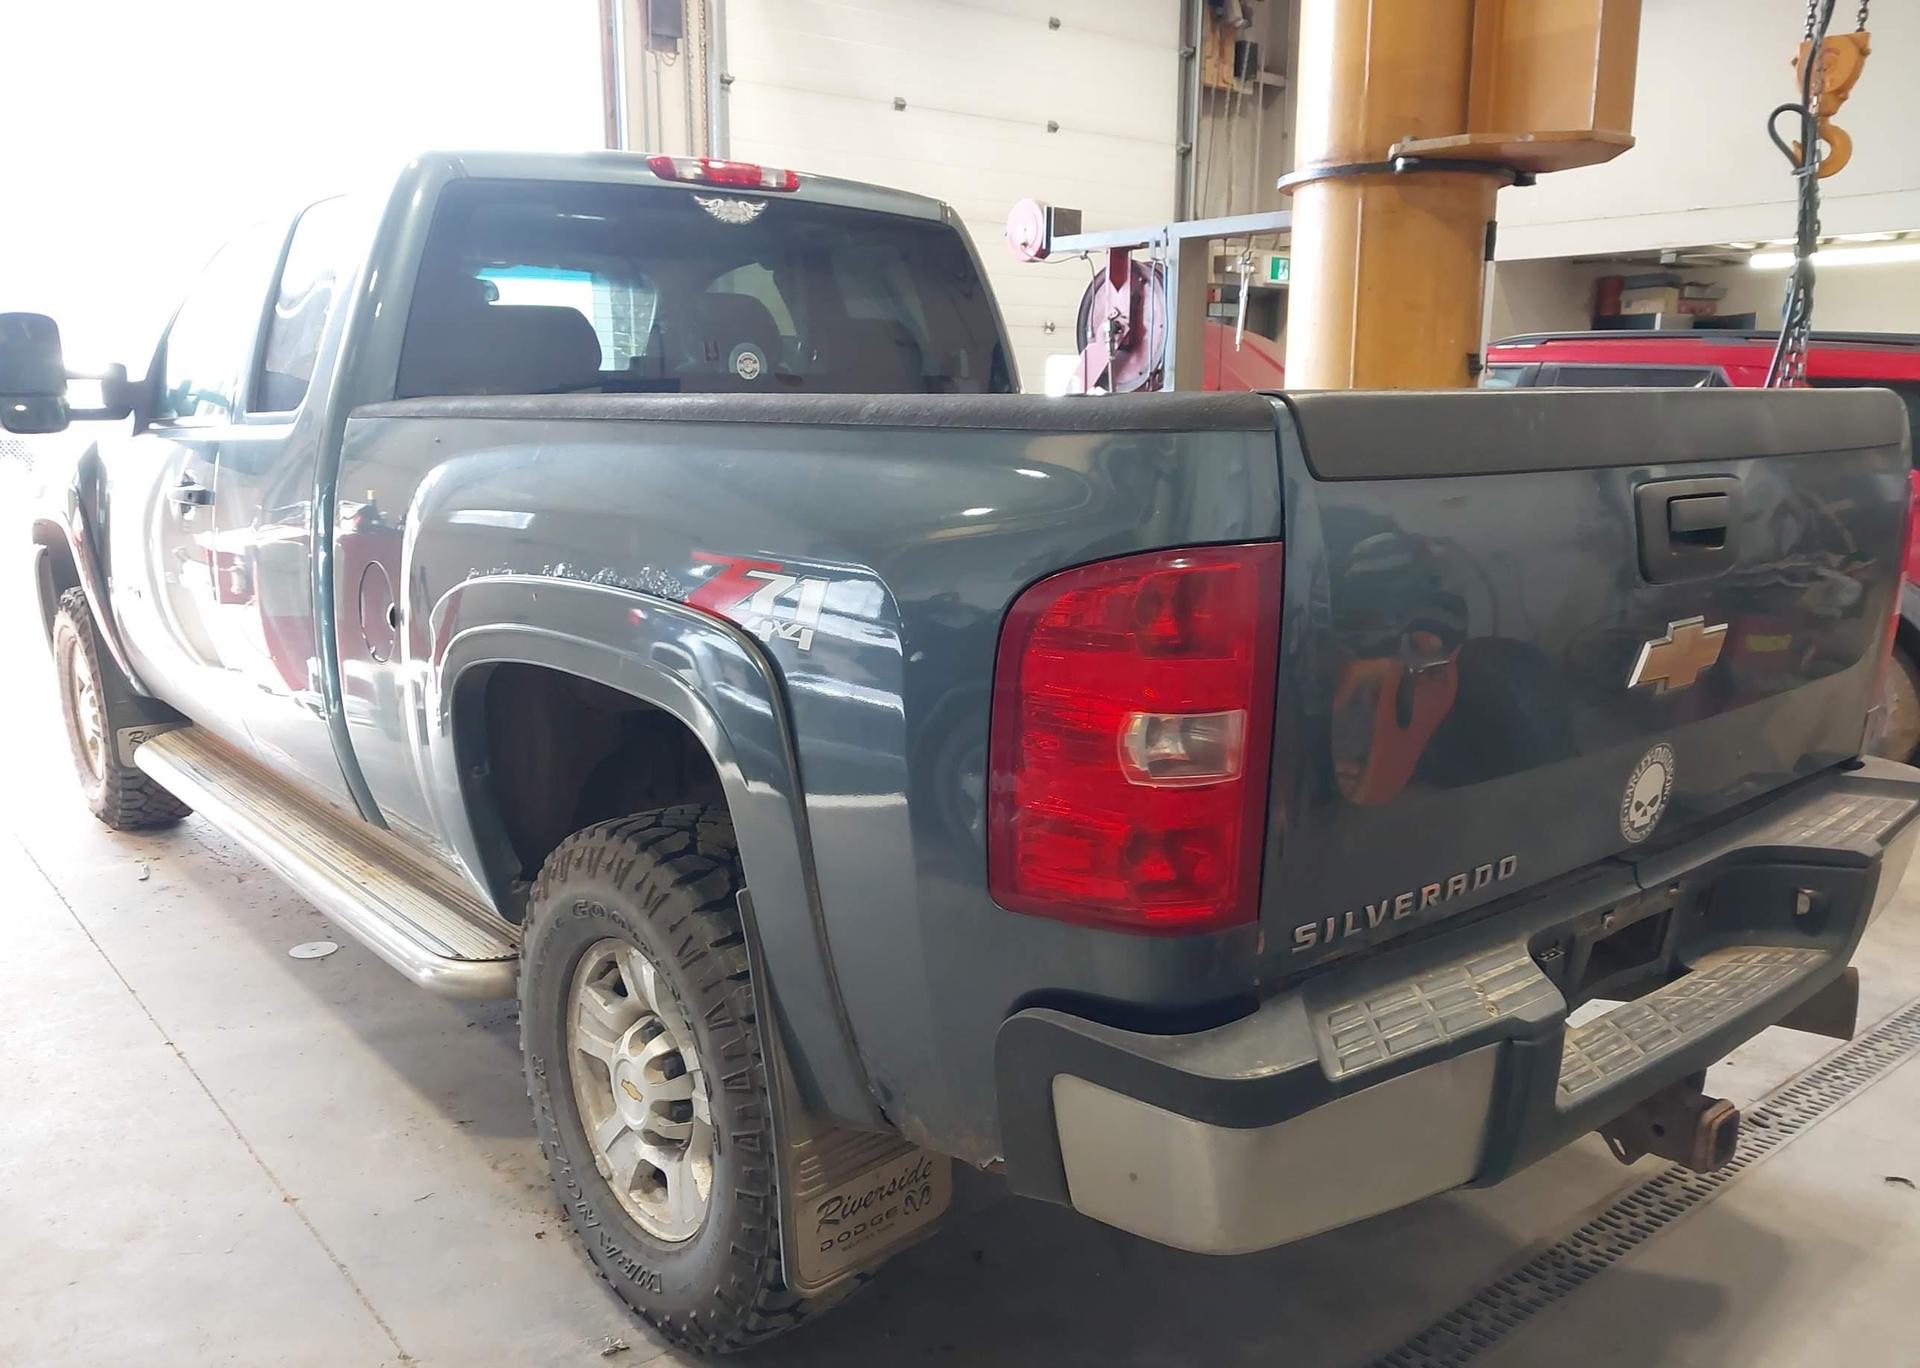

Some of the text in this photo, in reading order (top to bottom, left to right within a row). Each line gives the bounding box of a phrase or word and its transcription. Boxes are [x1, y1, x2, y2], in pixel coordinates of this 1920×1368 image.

[691, 551, 830, 624] Z71
[1291, 854, 1518, 953] SILVERADO
[816, 1156, 933, 1233] Riverside
[819, 1206, 899, 1253] DODGE
